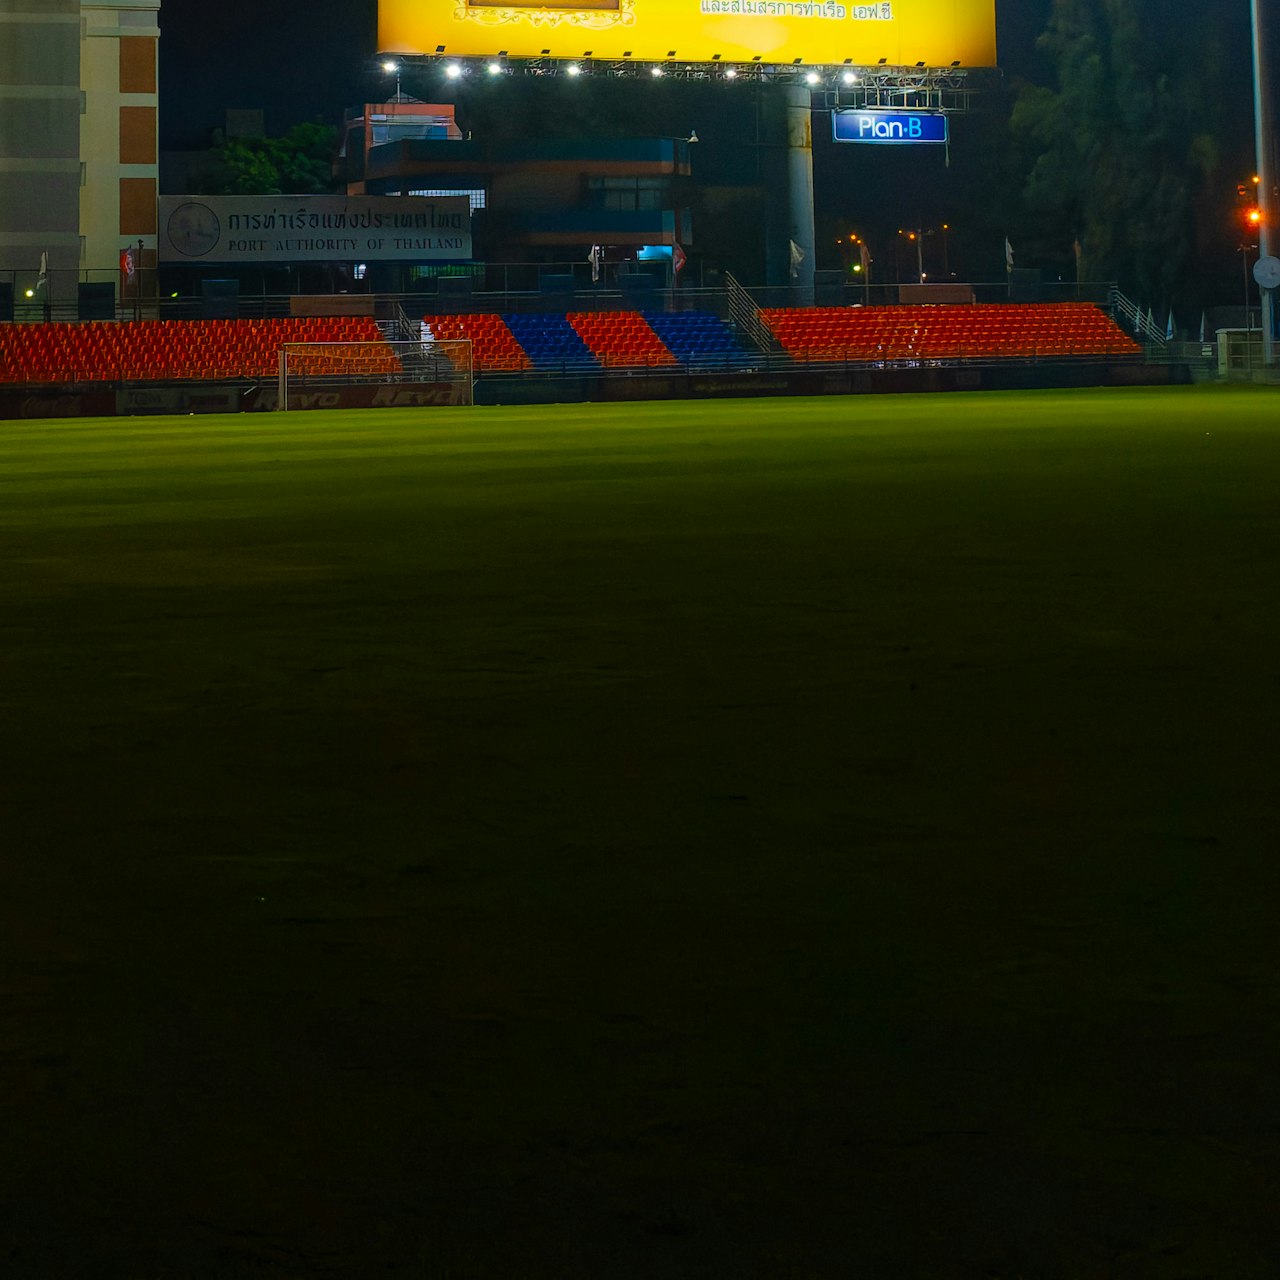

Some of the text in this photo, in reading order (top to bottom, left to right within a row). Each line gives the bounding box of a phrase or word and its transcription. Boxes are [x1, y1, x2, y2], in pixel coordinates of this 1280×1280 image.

[853, 2, 894, 20] เอฟ.ซี.
[228, 204, 463, 230] การท่าเรือแห่งประเทศไทย
[228, 238, 463, 252] PORT AUTHORITY OF THAILAND
